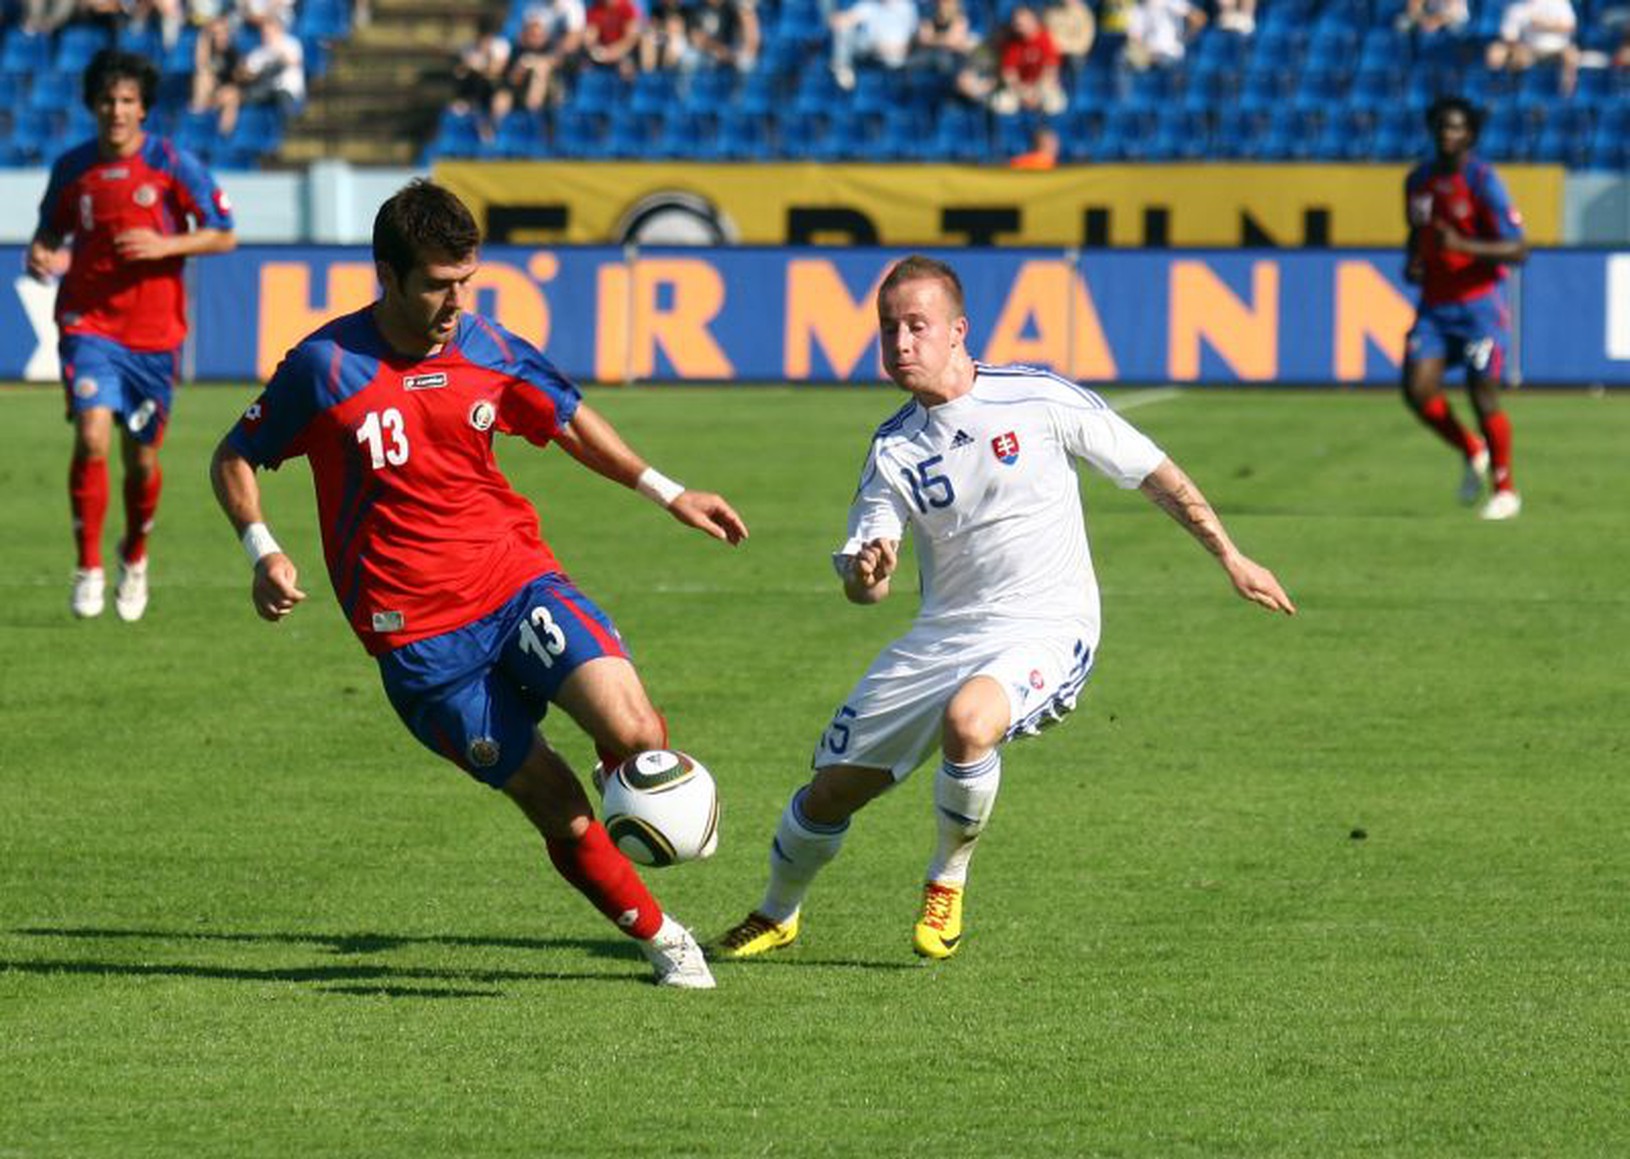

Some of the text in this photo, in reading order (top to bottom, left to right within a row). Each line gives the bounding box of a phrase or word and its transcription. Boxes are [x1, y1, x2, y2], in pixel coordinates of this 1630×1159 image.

[356, 407, 409, 470] 13
[900, 454, 955, 514] 15
[519, 606, 566, 668] 13
[821, 705, 857, 754] 5
